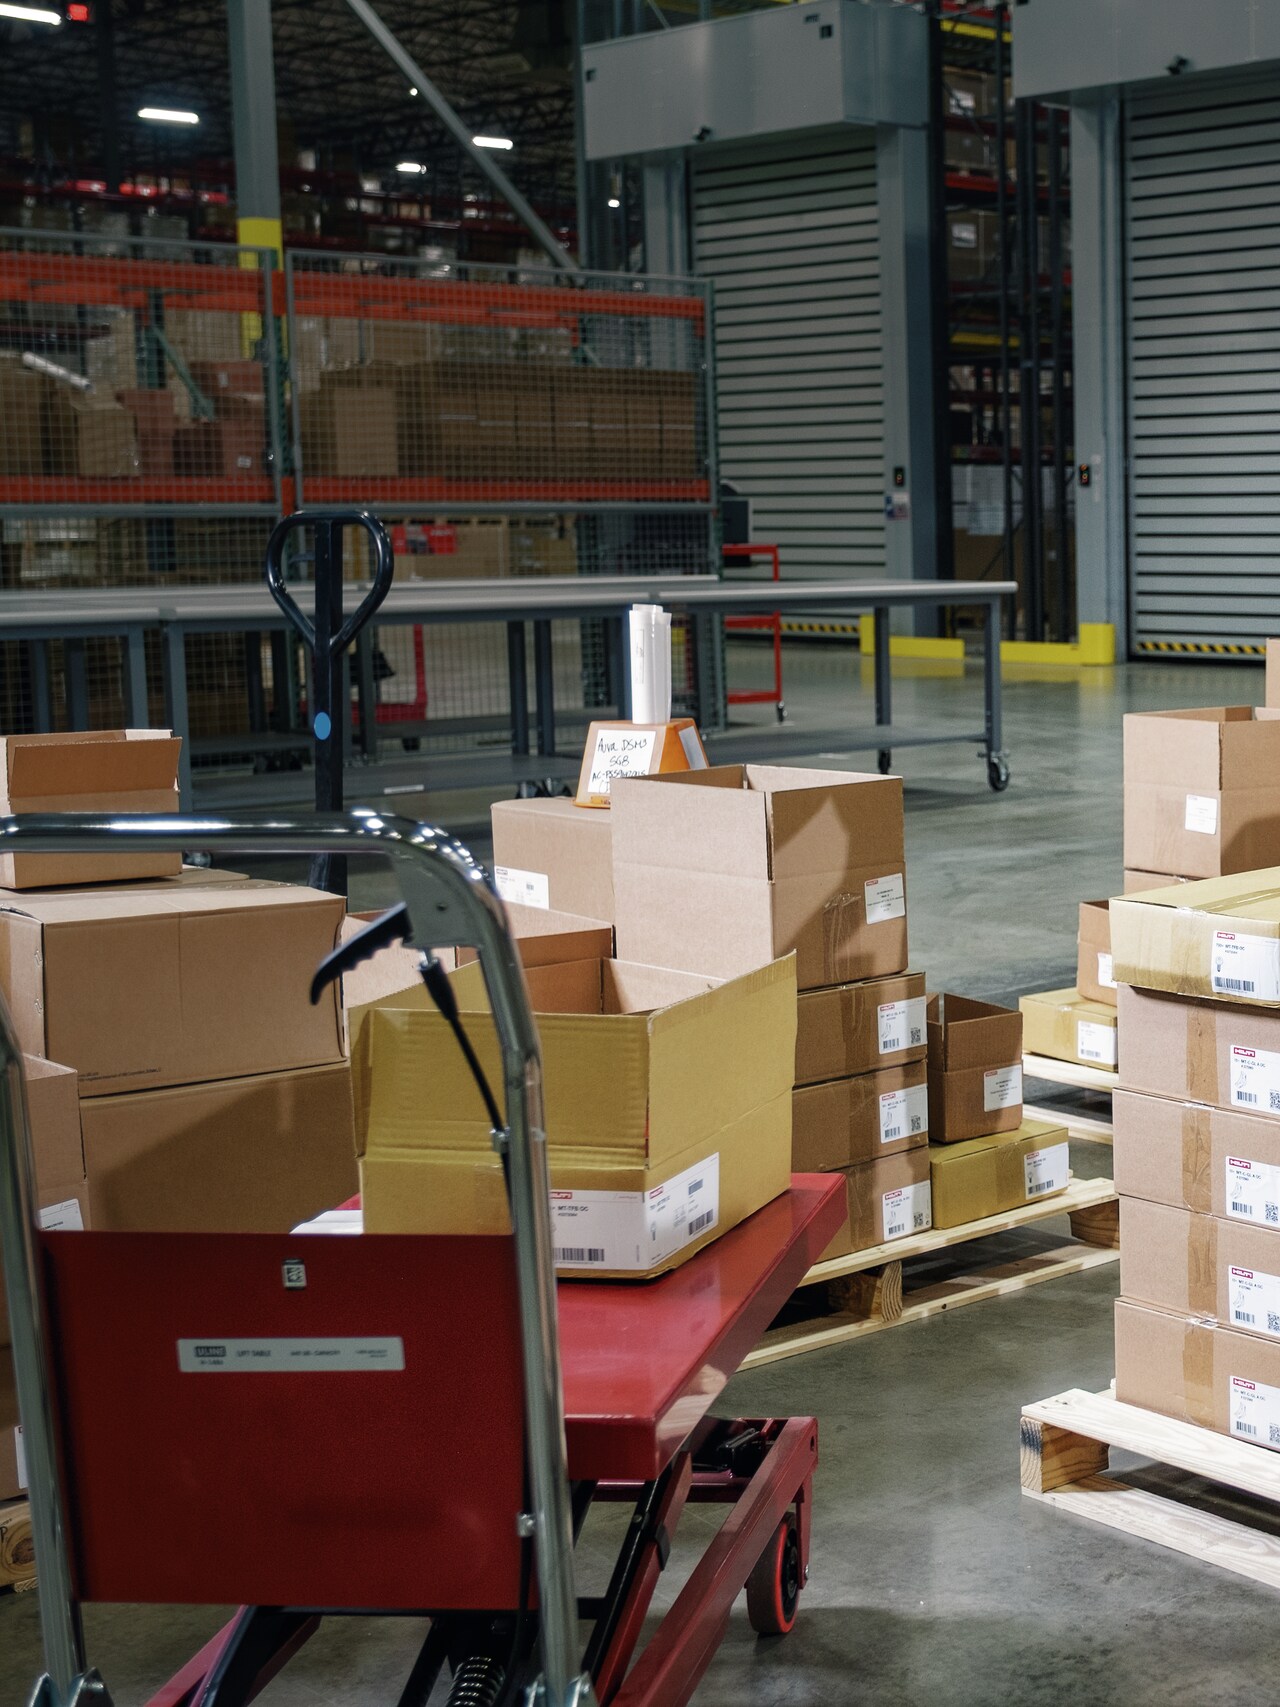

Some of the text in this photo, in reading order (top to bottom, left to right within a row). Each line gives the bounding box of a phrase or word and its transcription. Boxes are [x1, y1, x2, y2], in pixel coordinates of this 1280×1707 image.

[1234, 1047, 1255, 1057] HILTI
[1229, 1158, 1251, 1169] HILTI
[1232, 1268, 1253, 1279] HILTI
[1233, 1378, 1255, 1390] HILTI
